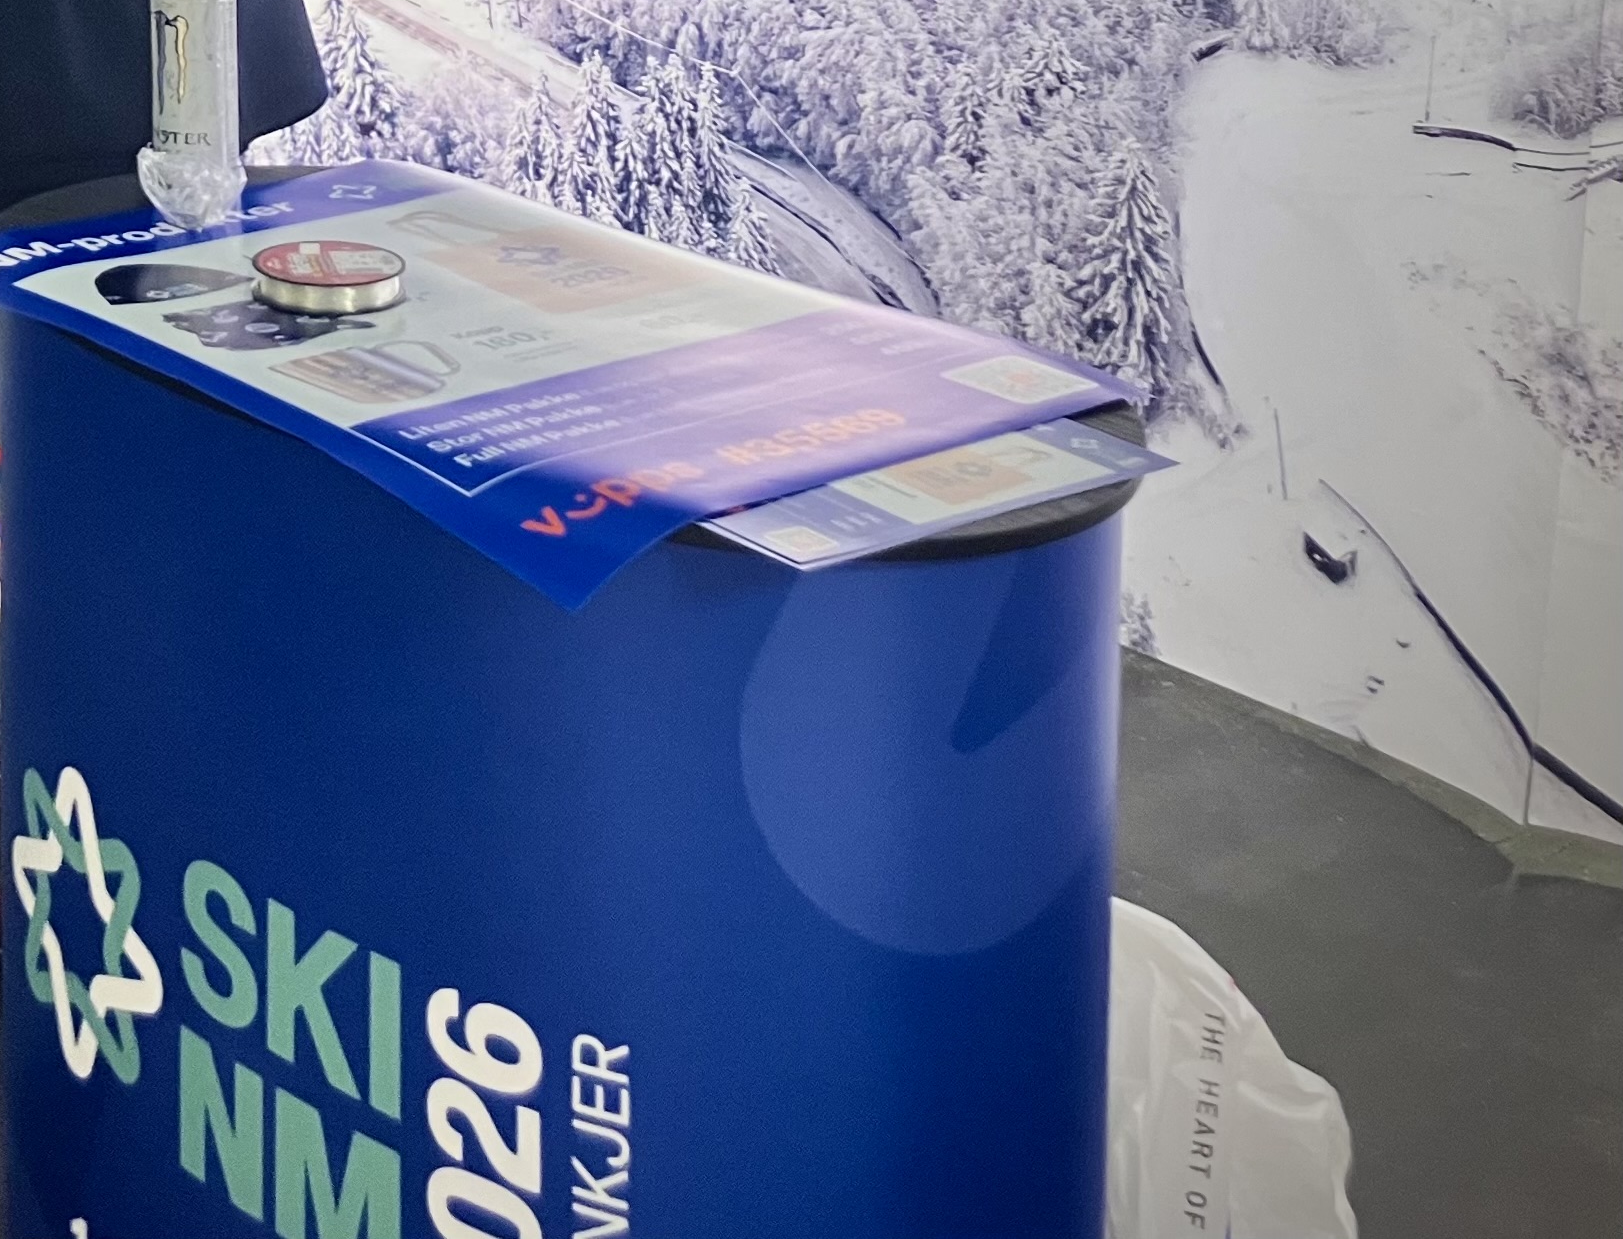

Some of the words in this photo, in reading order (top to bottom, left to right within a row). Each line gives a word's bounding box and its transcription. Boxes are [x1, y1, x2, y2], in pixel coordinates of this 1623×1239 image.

[426, 432, 485, 453] Stor
[480, 420, 529, 437] NM
[462, 408, 509, 424] NM
[452, 445, 507, 467] Full
[498, 432, 549, 451] NM
[180, 860, 402, 1123] SKI
[1199, 1012, 1225, 1064] THE
[179, 1024, 402, 1239] NM
[1189, 1078, 1221, 1179] HEART
[1183, 1190, 1208, 1231] OF
